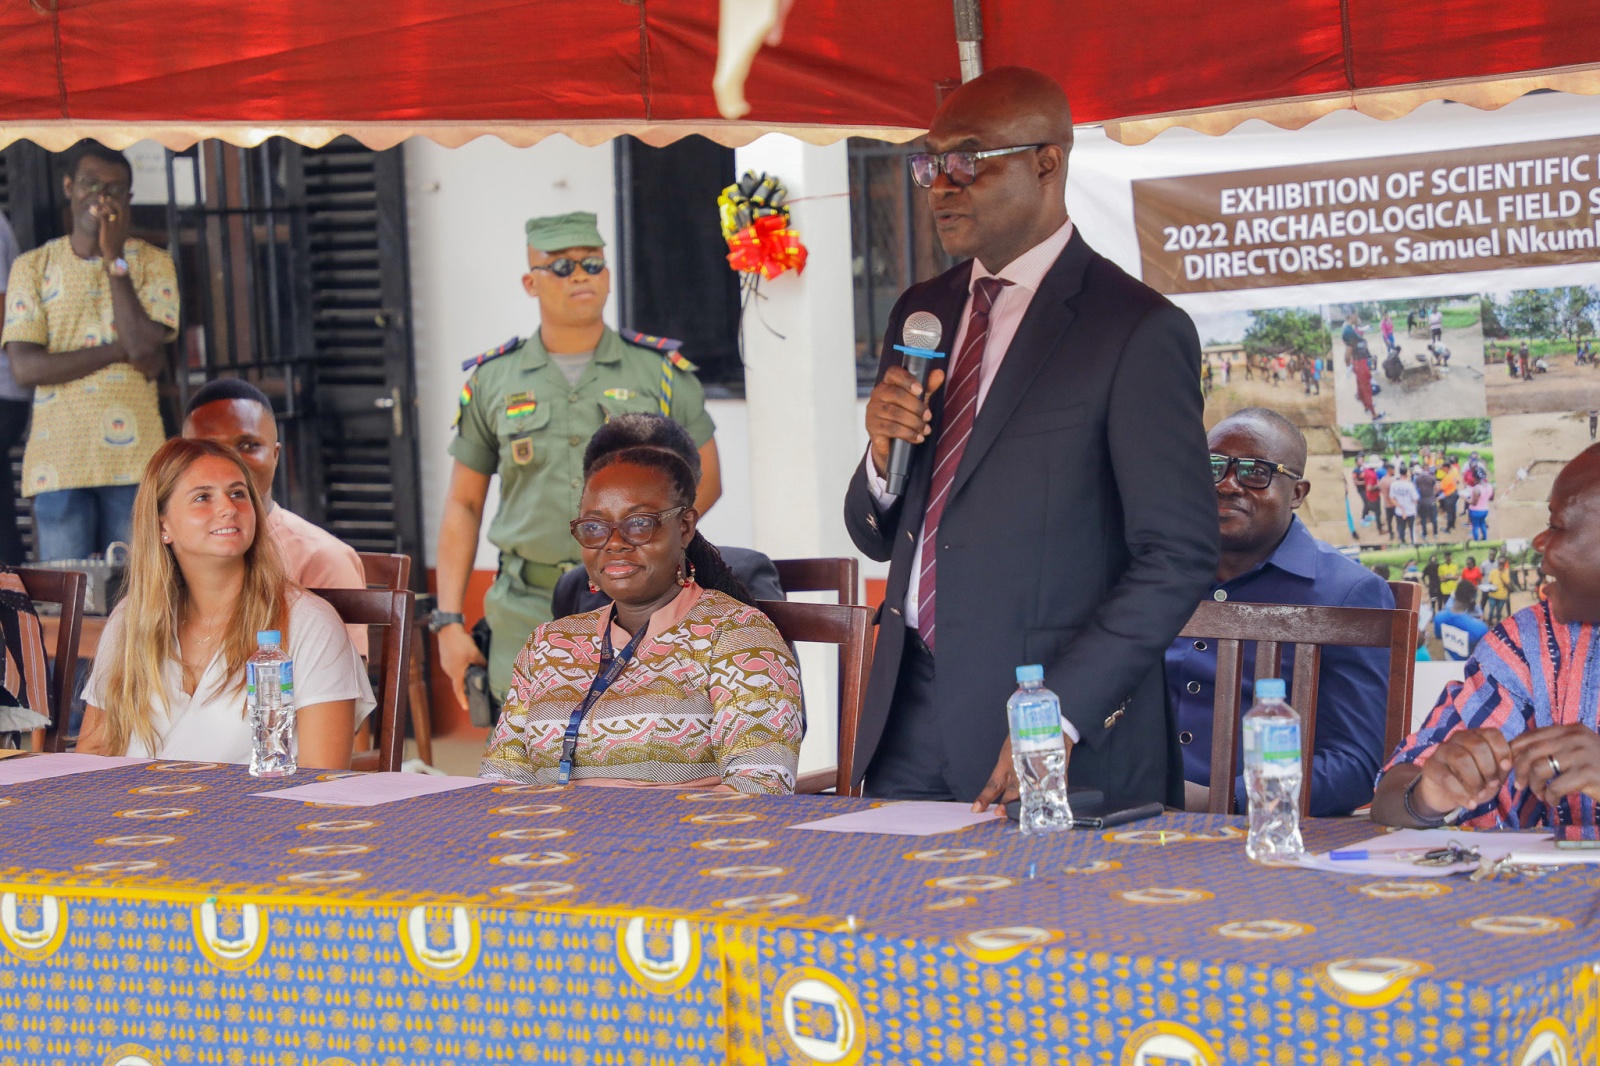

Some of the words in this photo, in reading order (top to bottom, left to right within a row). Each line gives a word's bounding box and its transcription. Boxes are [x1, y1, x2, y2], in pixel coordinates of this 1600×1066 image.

[1221, 175, 1379, 215] EXHIBITION
[1386, 172, 1424, 199] OF
[1431, 154, 1590, 196] SCIENTIFIC
[1163, 222, 1229, 251] 2022
[1234, 198, 1491, 246] ARCHAEOLOGICAL
[1498, 190, 1581, 223] FIELD
[1184, 243, 1344, 281] DIRECTORS:
[1349, 241, 1389, 268] Dr.
[1394, 228, 1499, 264] Samuel
